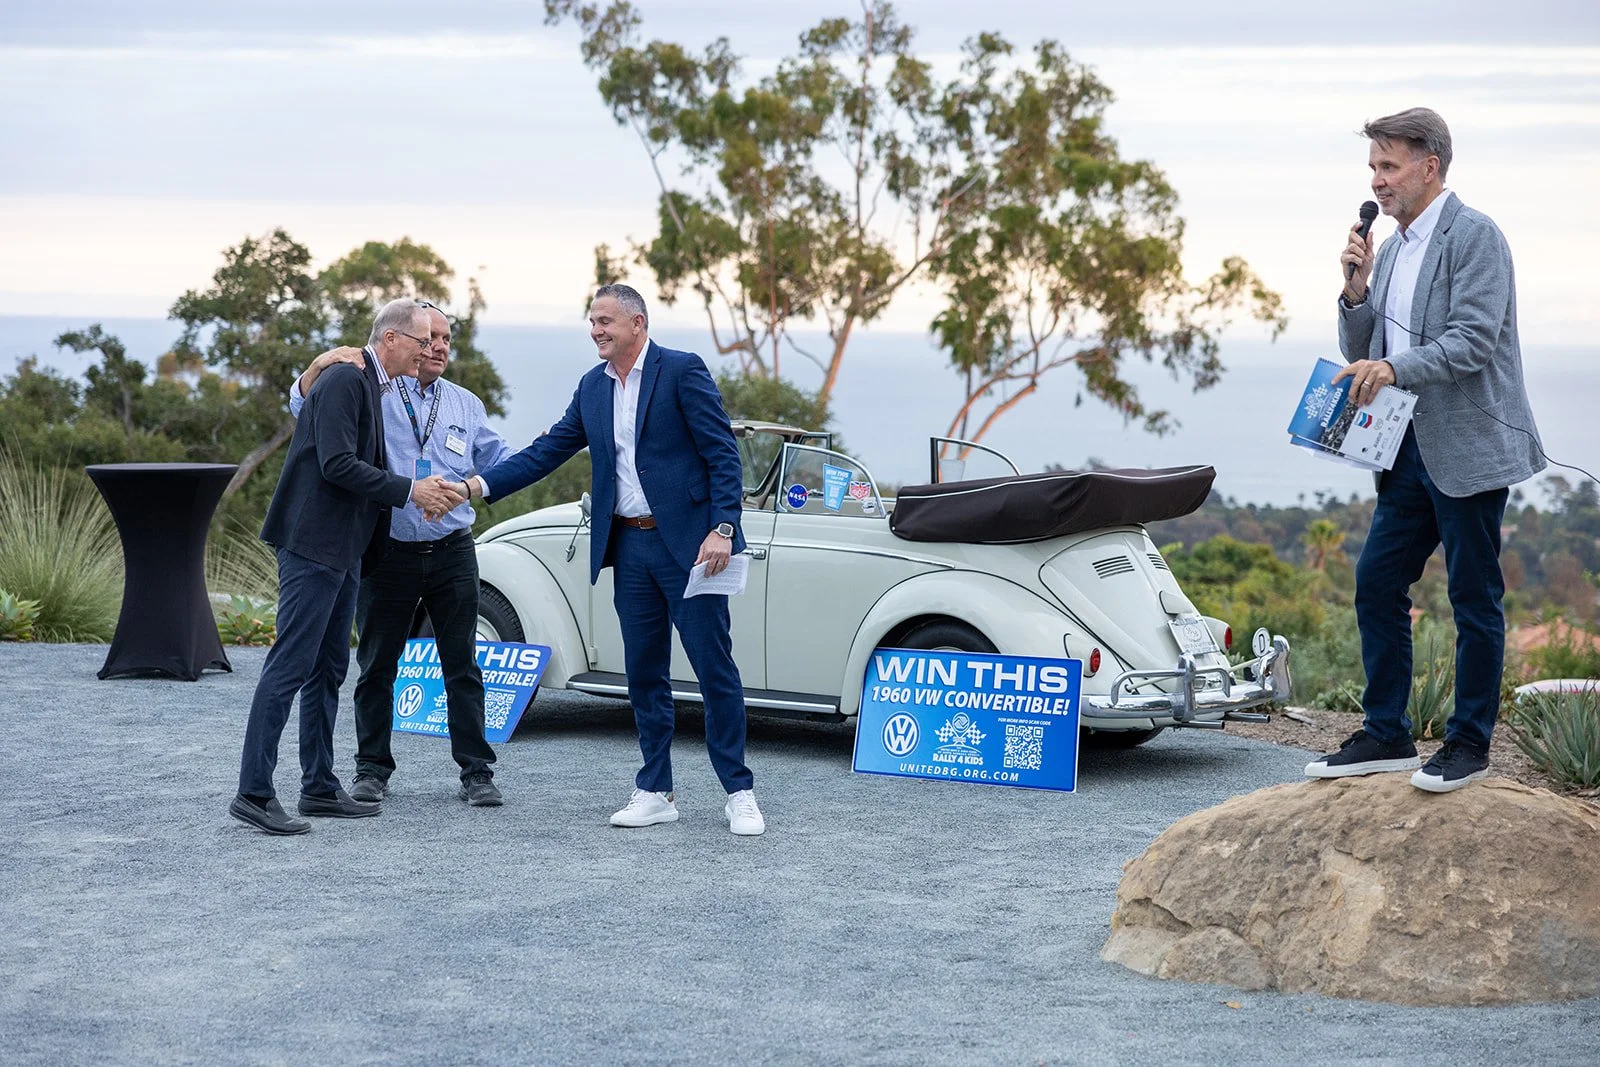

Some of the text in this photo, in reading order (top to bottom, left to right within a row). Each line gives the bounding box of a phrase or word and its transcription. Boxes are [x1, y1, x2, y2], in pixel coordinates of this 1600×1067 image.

[789, 491, 805, 501] NASA
[404, 642, 441, 663] WI
[396, 665, 423, 679] 1960
[481, 669, 537, 687] ERTIBLE!
[874, 656, 1068, 693] WIN THIS
[871, 685, 1070, 716] 1960 VW CONVERTIBLE!
[932, 753, 984, 766] RALLY 4 KIDS
[899, 763, 1019, 782] UNITEDBG.ORG.COM
